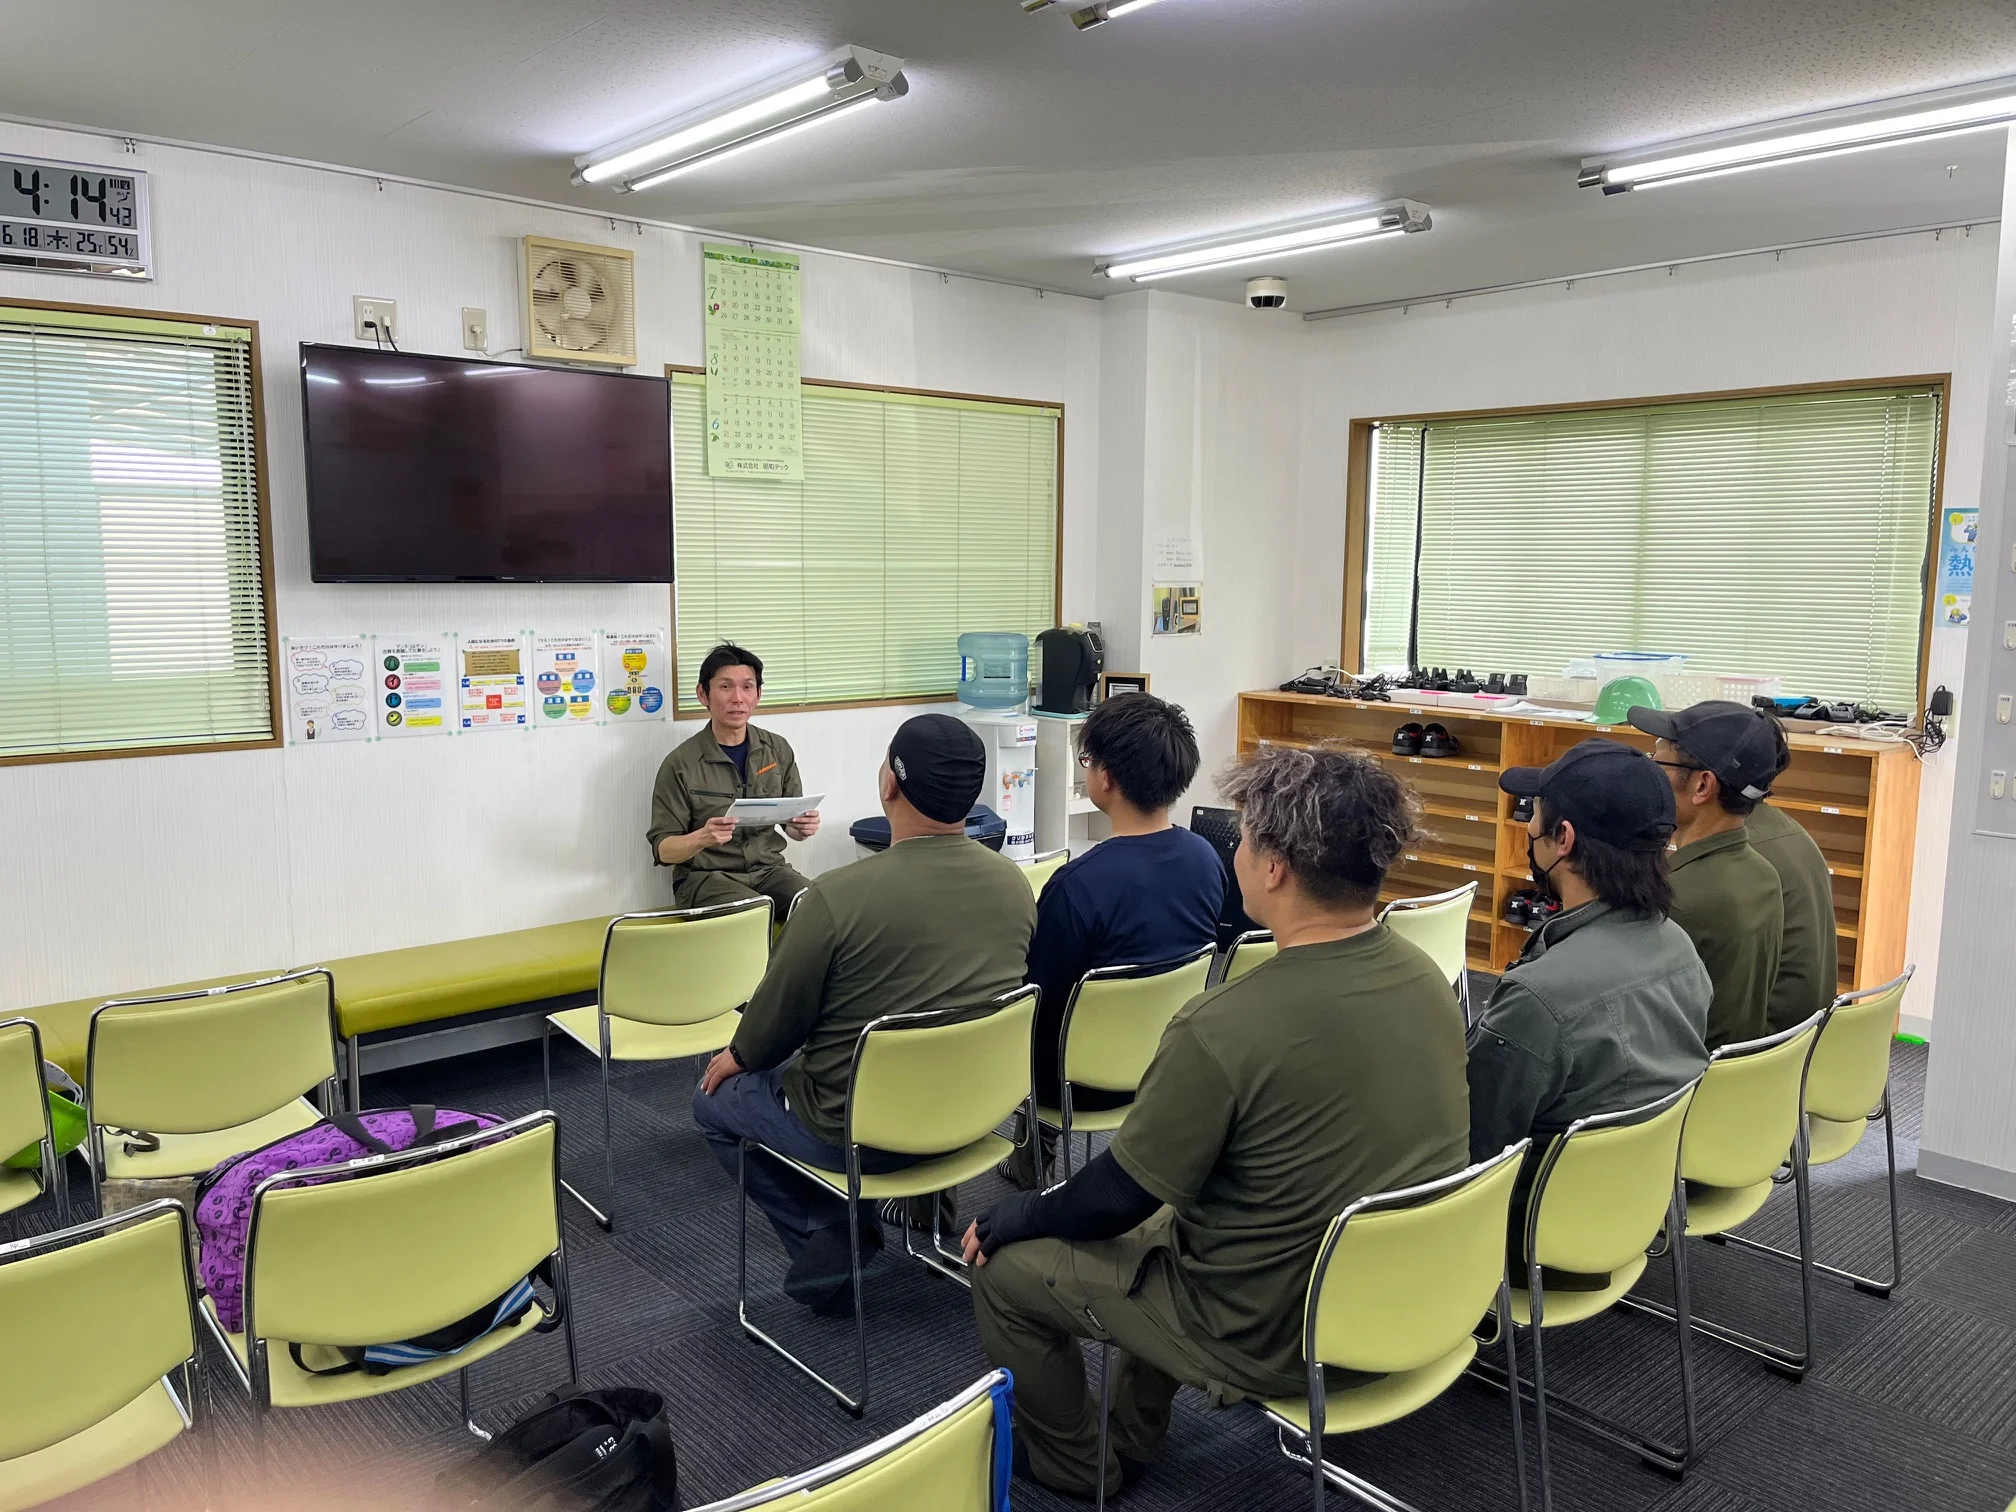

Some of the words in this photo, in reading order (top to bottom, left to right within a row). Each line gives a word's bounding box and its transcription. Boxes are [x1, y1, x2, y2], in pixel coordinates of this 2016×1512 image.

[14, 168, 106, 223] 4:14
[46, 230, 68, 250] 木
[710, 286, 717, 299] 7
[710, 353, 718, 365] 8
[712, 418, 719, 430] 6
[1948, 554, 1973, 576] 熱
